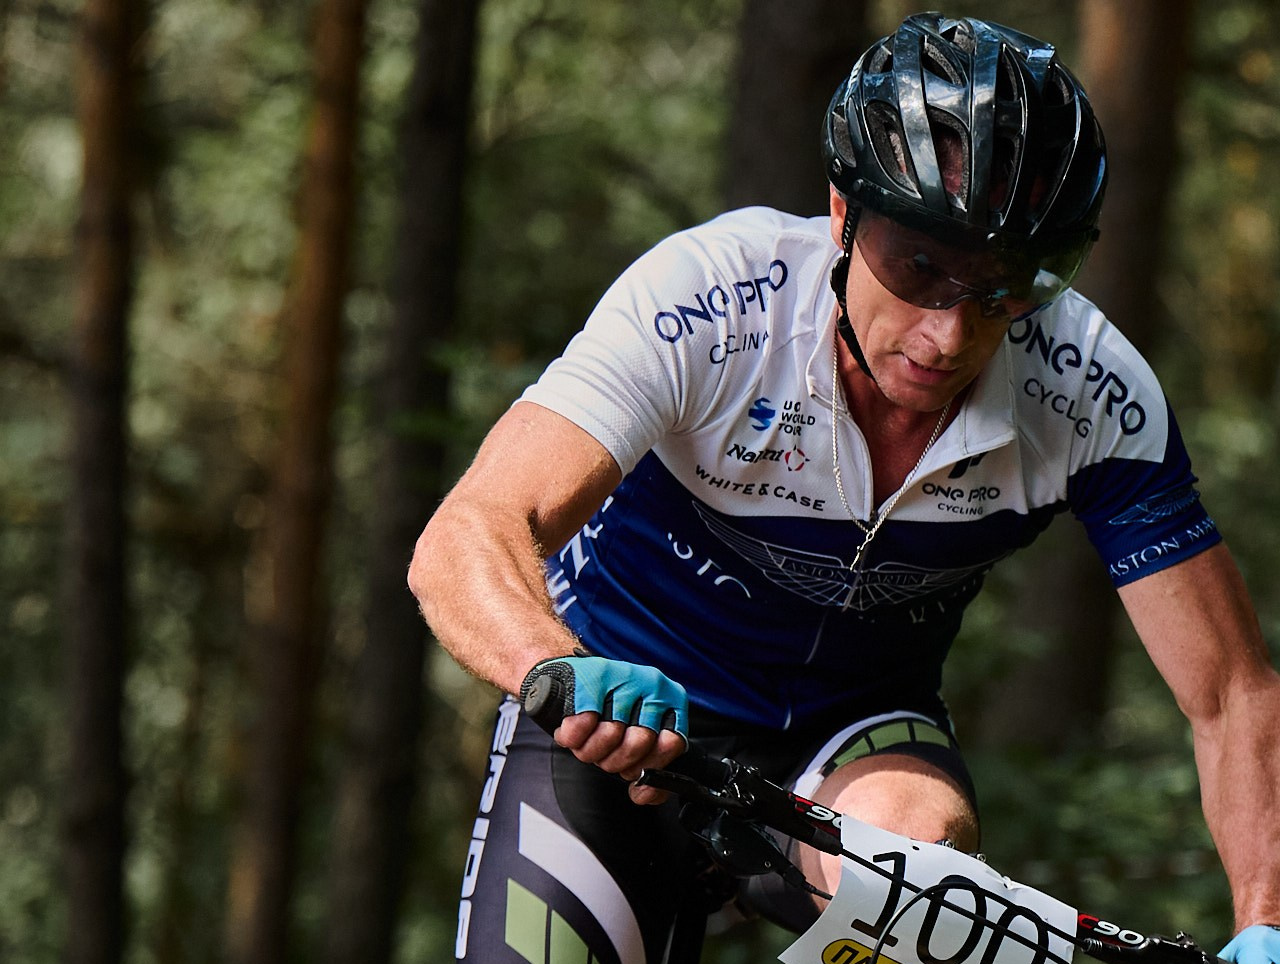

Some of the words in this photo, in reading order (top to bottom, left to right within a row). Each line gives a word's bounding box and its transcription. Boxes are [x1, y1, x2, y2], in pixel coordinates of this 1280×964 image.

[695, 464, 755, 495] WHITE
[758, 483, 770, 496] &
[773, 486, 826, 511] CASE
[968, 486, 1001, 503] PRO
[937, 503, 984, 516] CYCLING
[1109, 537, 1180, 578] ASTON
